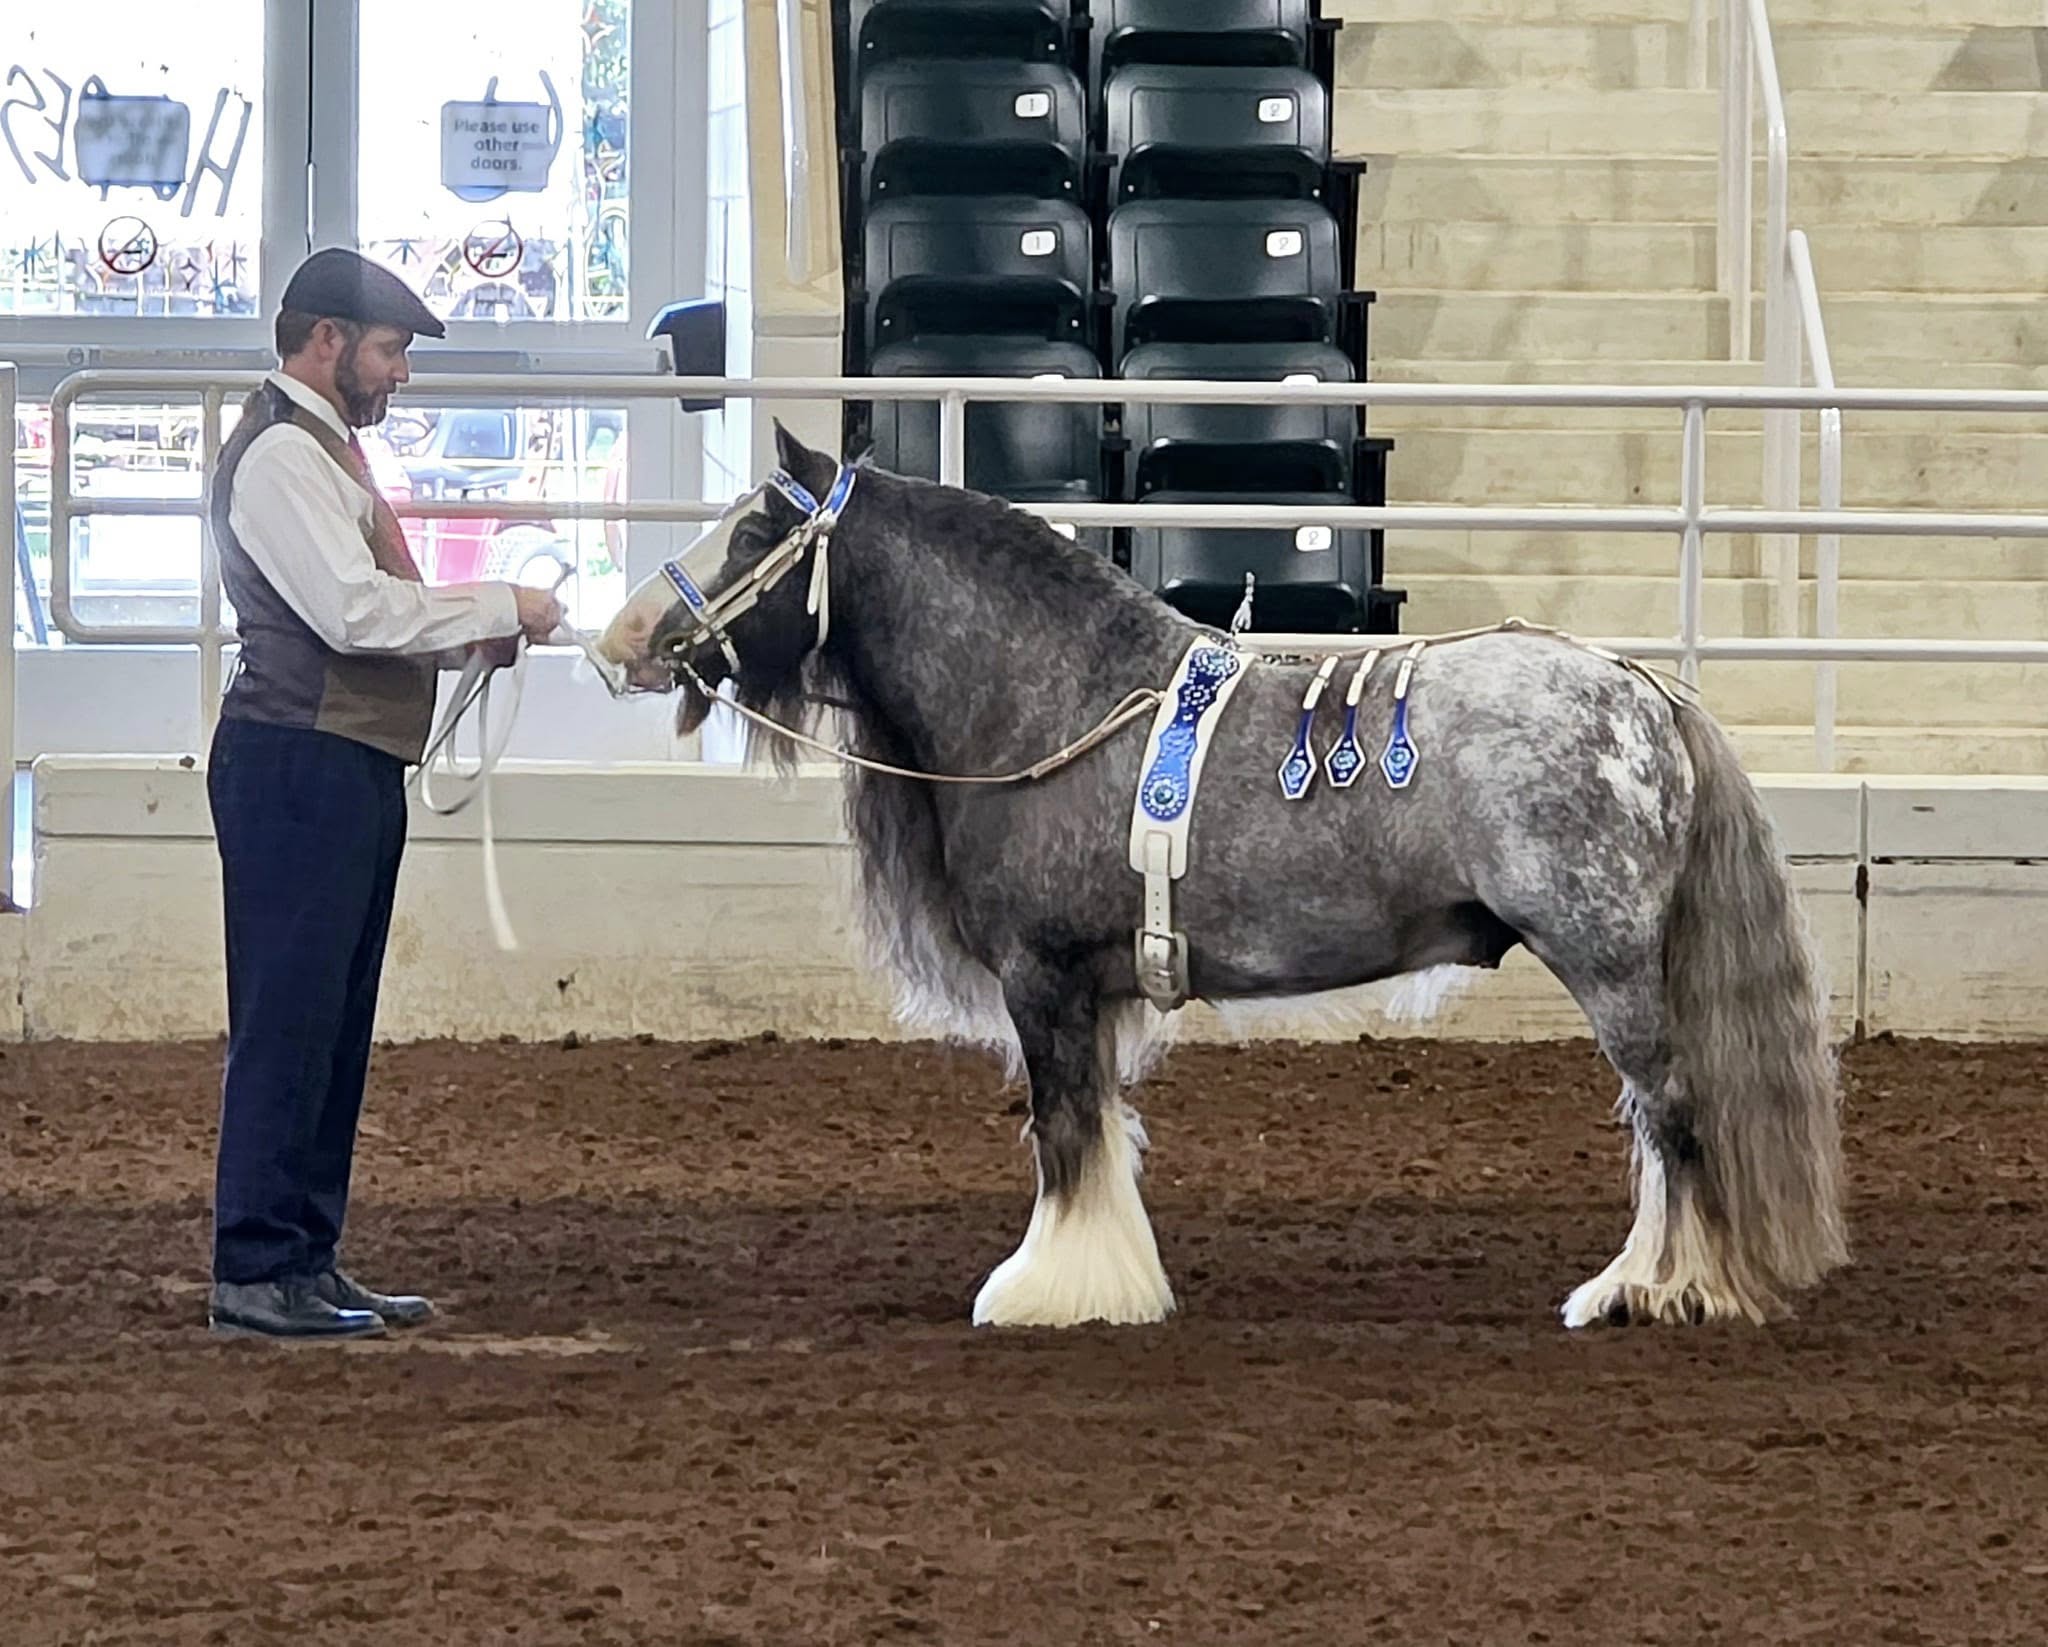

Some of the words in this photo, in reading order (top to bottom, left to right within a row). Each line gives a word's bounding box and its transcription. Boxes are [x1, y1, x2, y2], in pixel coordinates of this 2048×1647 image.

[454, 119, 507, 133] Please
[511, 121, 540, 133] use
[474, 138, 519, 151] other
[470, 157, 523, 171] doors.
